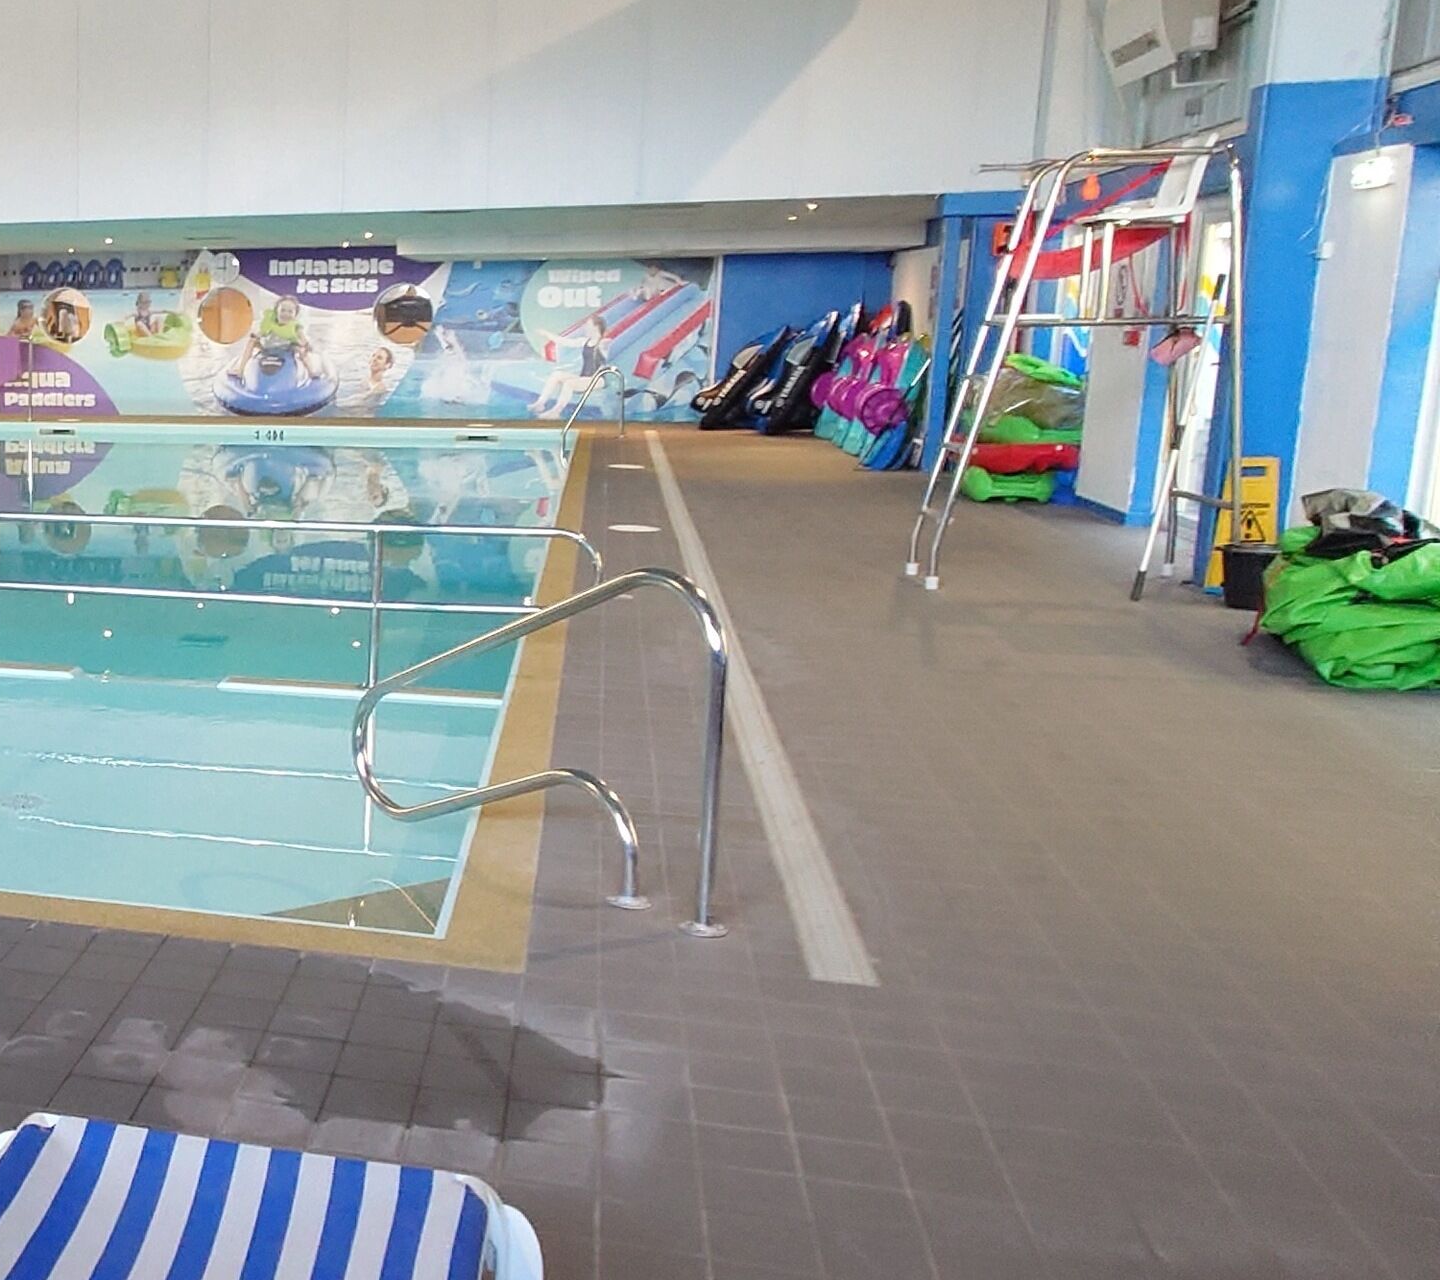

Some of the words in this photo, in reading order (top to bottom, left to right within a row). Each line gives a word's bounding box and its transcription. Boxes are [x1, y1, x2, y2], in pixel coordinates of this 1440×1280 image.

[269, 258, 394, 275] Inflatable
[296, 279, 329, 293] Jet
[330, 278, 378, 293] Skis
[538, 286, 601, 308] Out
[4, 371, 71, 389] qua
[4, 392, 96, 408] Paddlers
